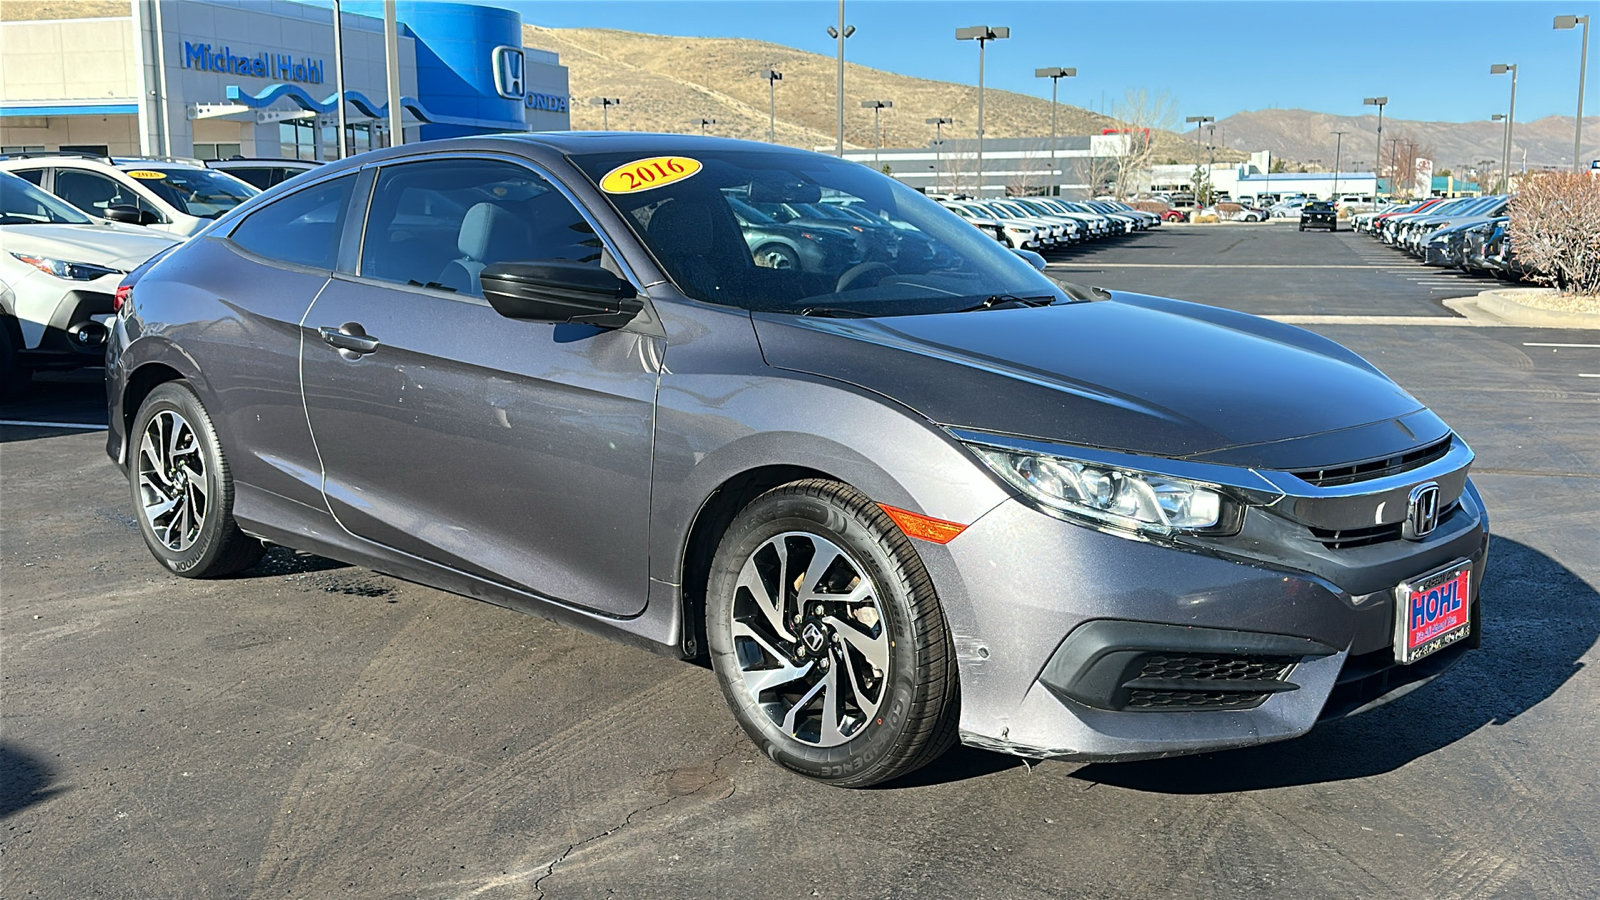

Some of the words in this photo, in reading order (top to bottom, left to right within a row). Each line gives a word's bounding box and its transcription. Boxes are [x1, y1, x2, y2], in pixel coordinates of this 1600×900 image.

[184, 41, 270, 78] Michael
[277, 53, 324, 84] Hohl
[525, 91, 568, 113] ONDA
[619, 158, 685, 190] 2016
[1411, 580, 1462, 631] HOHL
